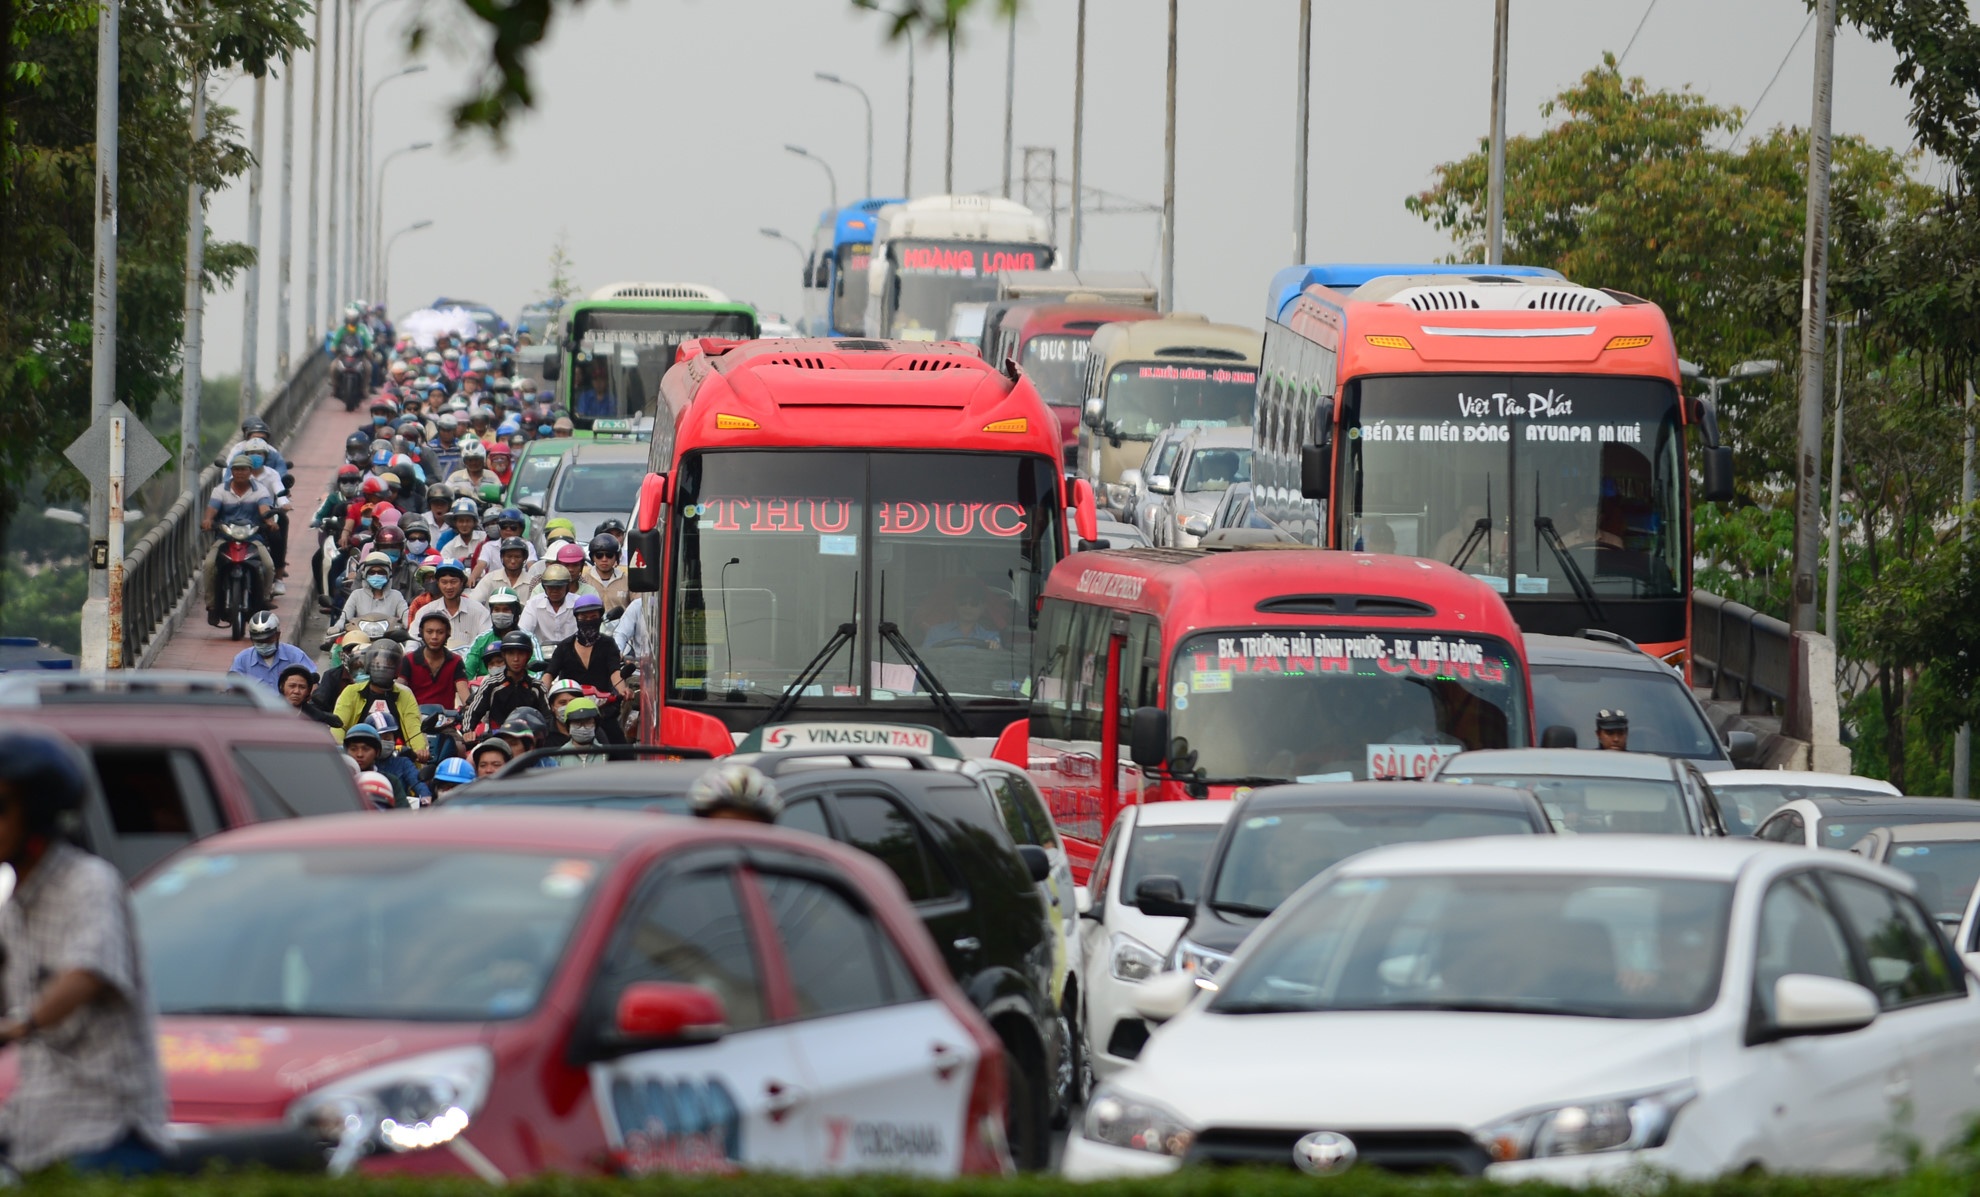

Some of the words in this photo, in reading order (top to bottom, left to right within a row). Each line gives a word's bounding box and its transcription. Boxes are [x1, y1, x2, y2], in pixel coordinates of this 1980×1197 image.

[904, 247, 974, 271] HOÀNG
[983, 251, 1035, 273] LONG
[1458, 392, 1490, 418] Việt
[1492, 392, 1526, 418] Tân
[1527, 390, 1573, 419] Phát
[1363, 419, 1393, 442] BẾN
[1395, 424, 1415, 442] XE
[1419, 420, 1460, 442] MIỀN
[1462, 422, 1511, 443] ĐÔNG
[1525, 424, 1592, 443] AYUNPA
[1598, 425, 1615, 442] AN
[1617, 422, 1641, 443] KHÊ
[1218, 638, 1239, 658] BX.
[1240, 632, 1289, 658] TRƯỜNG
[1290, 632, 1312, 657] HẢI
[1313, 634, 1344, 658] BÌNH
[1344, 634, 1385, 659] PHƯỚC
[1394, 639, 1416, 659] BX.
[1417, 636, 1448, 661] MIỀN
[1449, 639, 1483, 664] ĐÔNG
[1373, 746, 1406, 778] SÀI
[1413, 746, 1448, 778] GÒ
